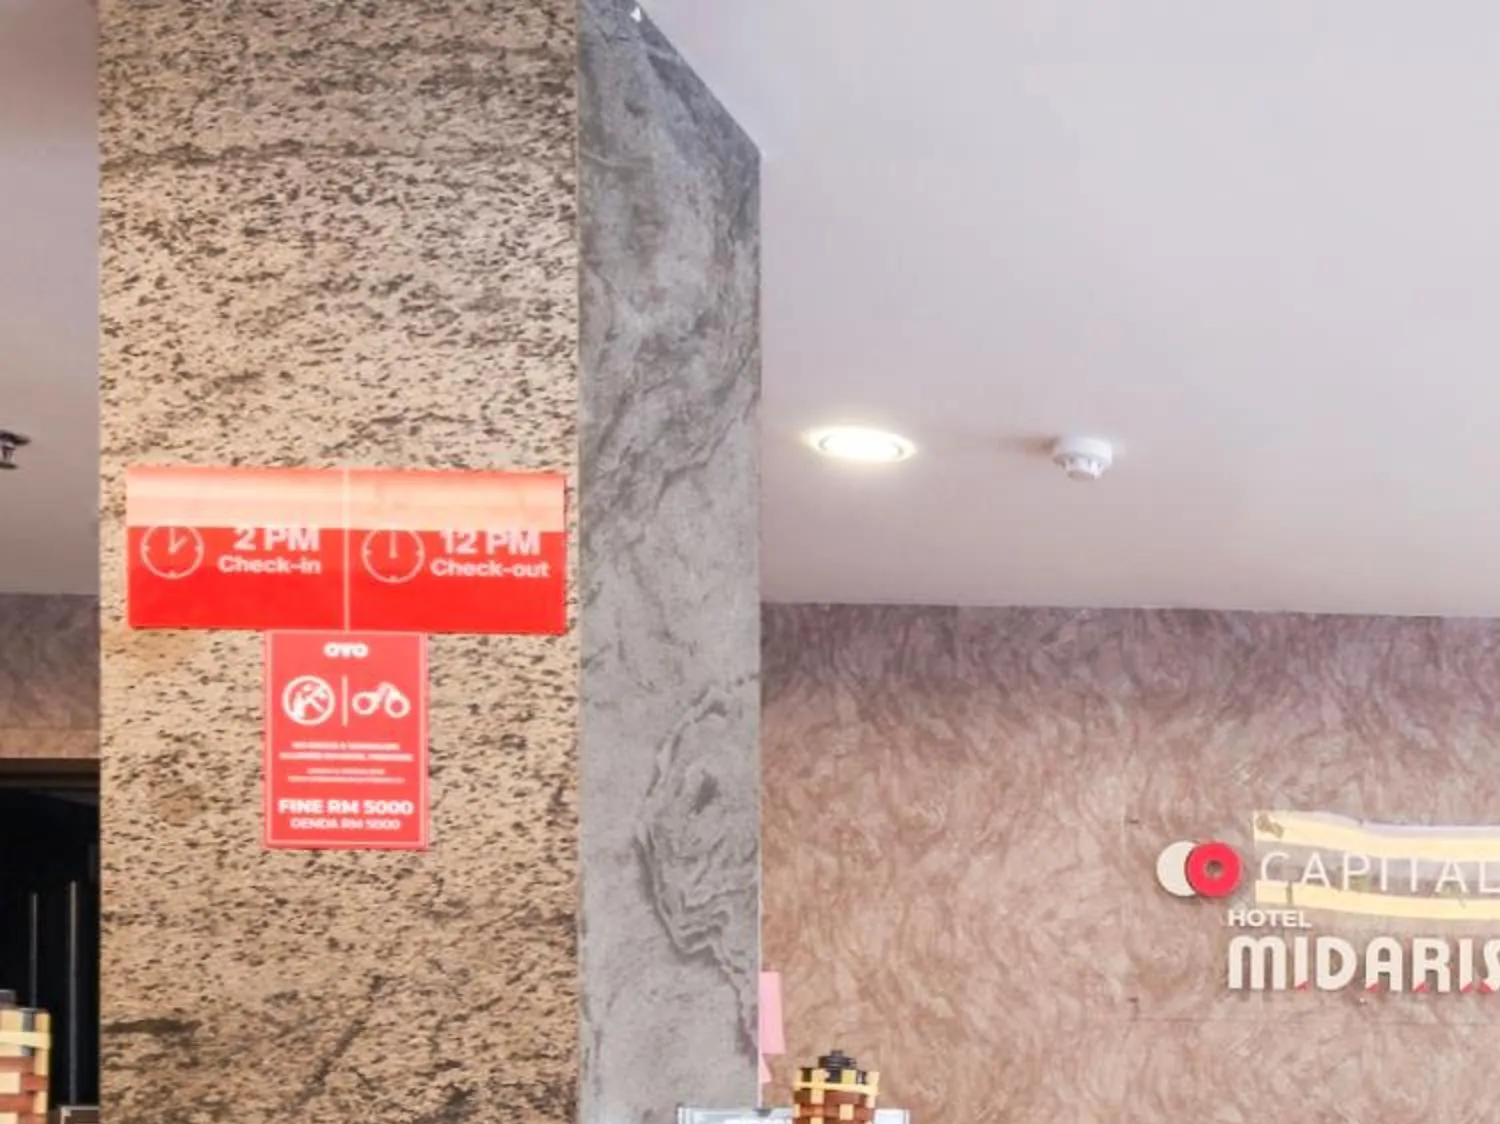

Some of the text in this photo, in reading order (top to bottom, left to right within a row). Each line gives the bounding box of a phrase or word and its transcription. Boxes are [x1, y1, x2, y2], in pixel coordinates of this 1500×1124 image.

[233, 523, 320, 552] 2 PM
[440, 526, 541, 556] 12 PM
[217, 554, 321, 574] Check-in
[430, 558, 549, 577] Check-out
[278, 799, 414, 815] FINE RM 5000
[1228, 909, 1312, 928] HOTEL
